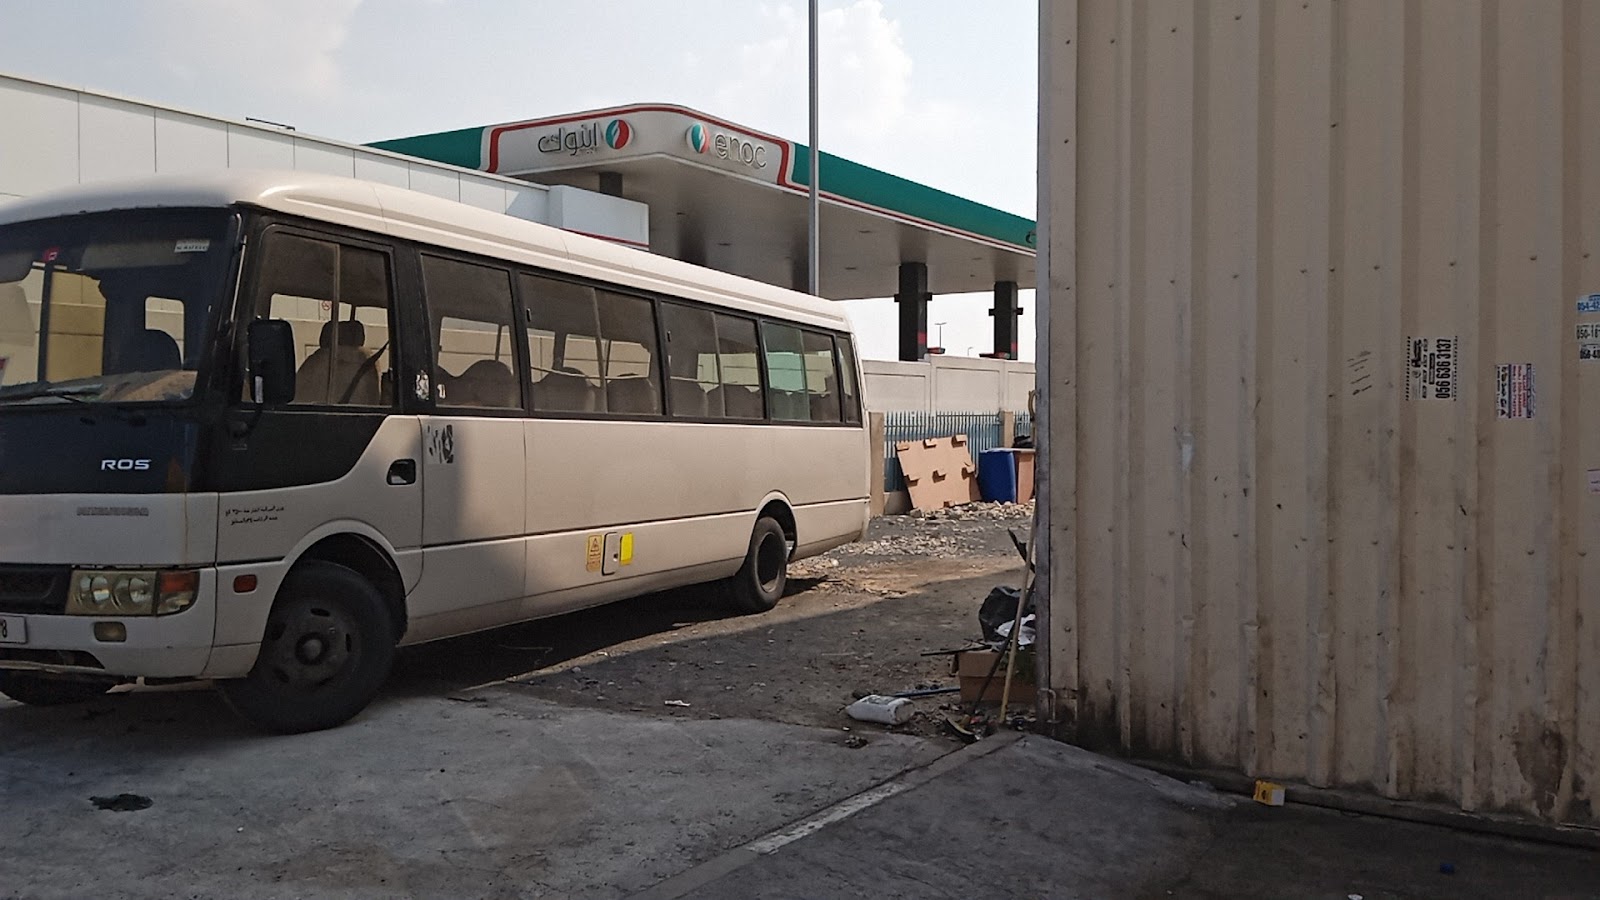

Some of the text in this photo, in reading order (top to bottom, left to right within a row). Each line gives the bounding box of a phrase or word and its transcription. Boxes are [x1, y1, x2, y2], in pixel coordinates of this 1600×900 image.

[714, 134, 767, 169] enoc
[1435, 338, 1452, 399] 056 636 3137
[100, 458, 152, 471] ROS
